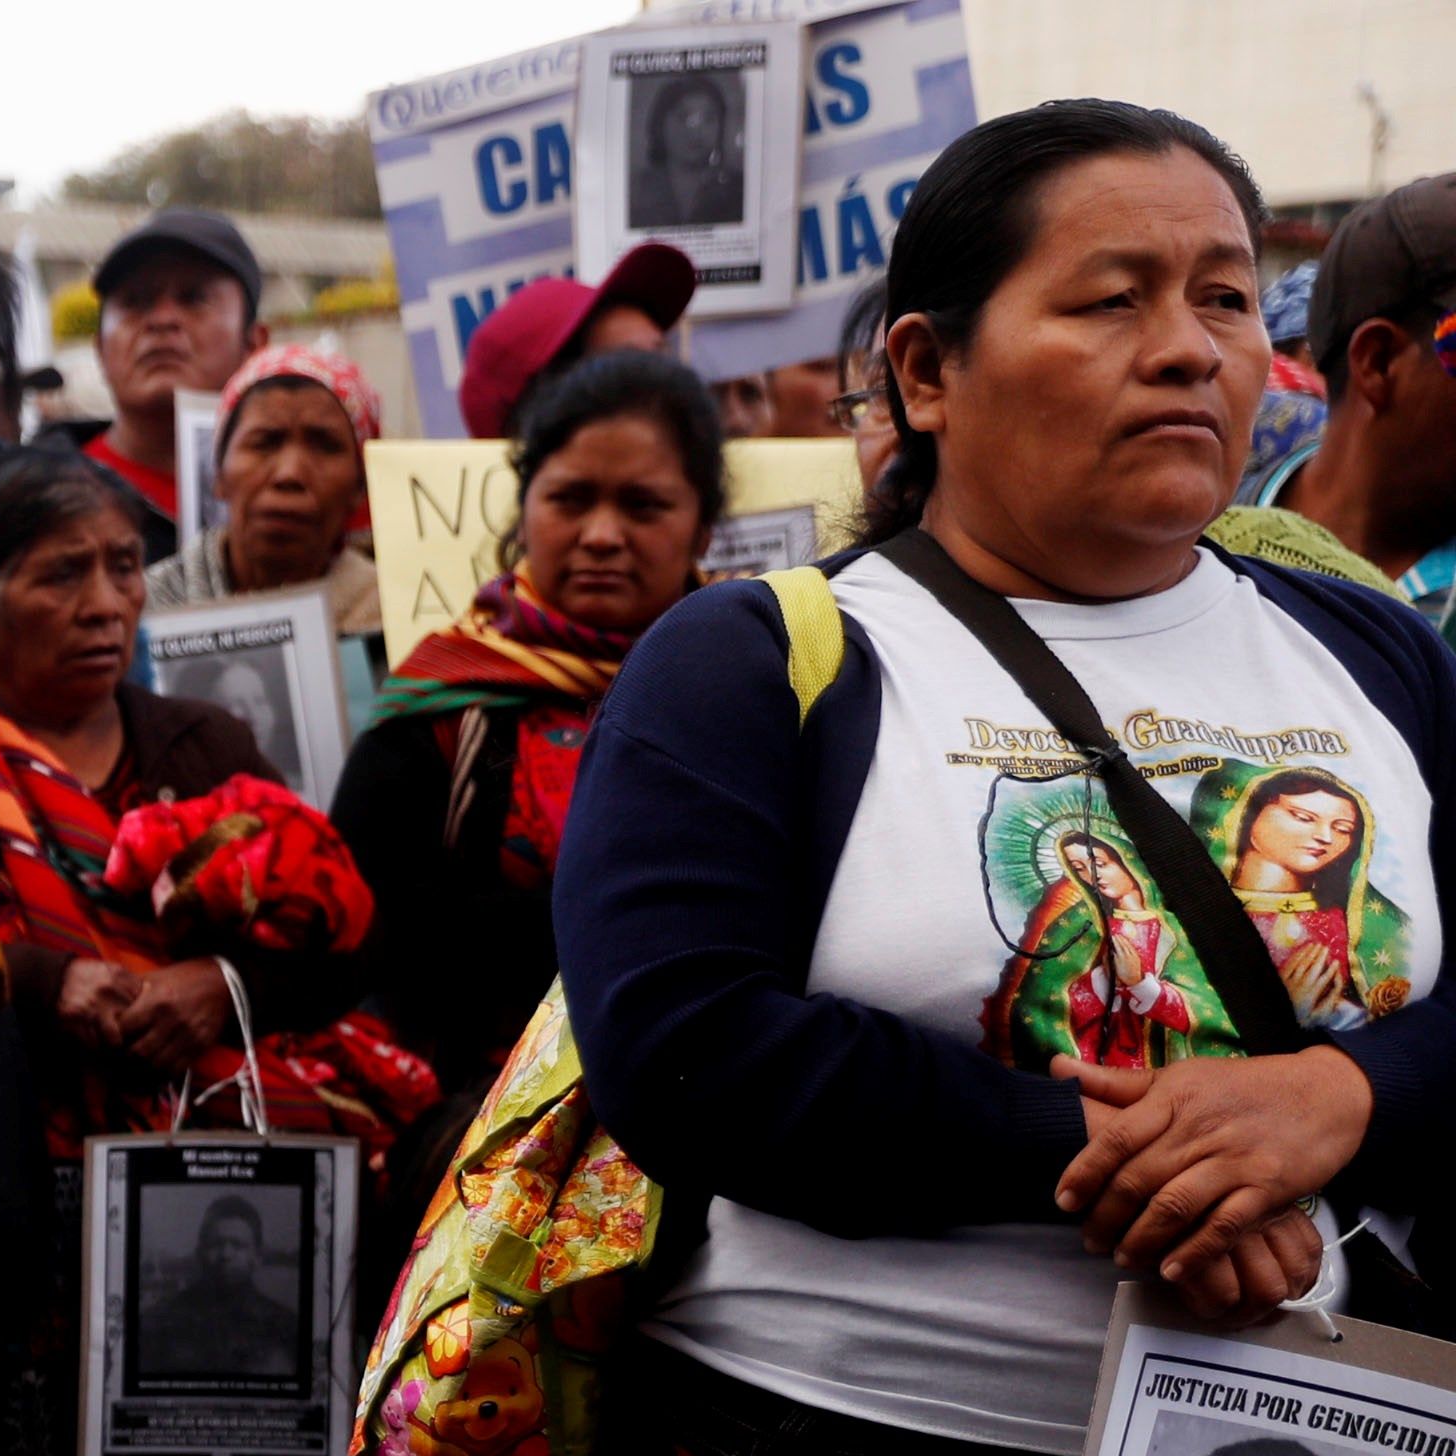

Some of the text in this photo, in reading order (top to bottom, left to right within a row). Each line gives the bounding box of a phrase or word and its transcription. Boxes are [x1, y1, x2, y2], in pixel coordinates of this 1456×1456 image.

[1124, 708, 1348, 765] Guadalupana
[1156, 763, 1181, 777] tus
[1181, 756, 1219, 774] hijos
[1145, 1373, 1249, 1413] JUSTICIA
[1251, 1391, 1303, 1425] POR
